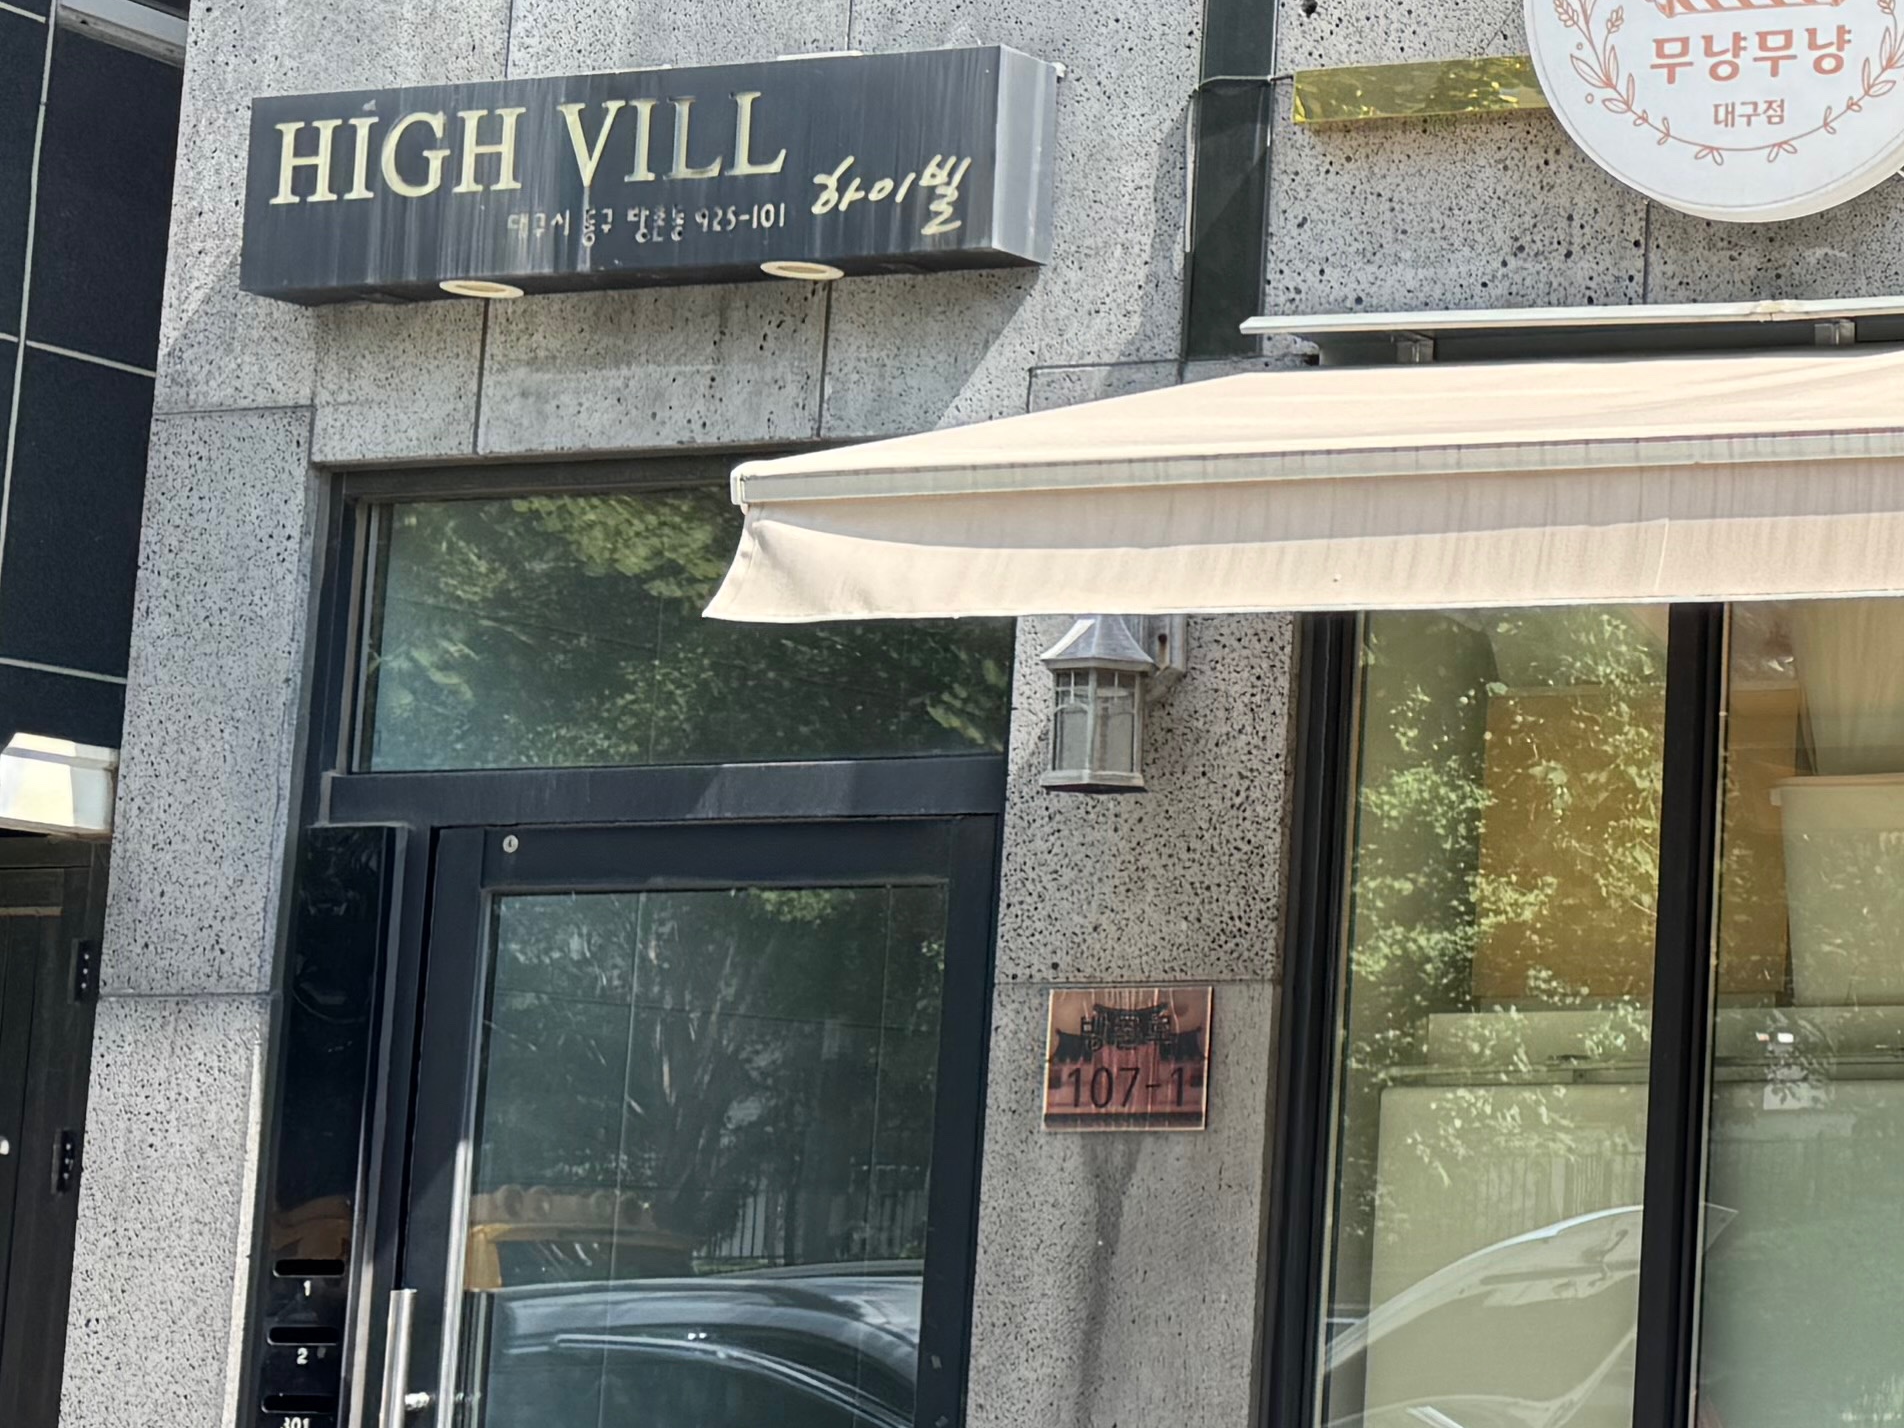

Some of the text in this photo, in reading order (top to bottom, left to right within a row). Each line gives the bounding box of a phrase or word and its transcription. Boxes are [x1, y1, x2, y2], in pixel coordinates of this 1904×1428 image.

[1650, 24, 1852, 85] 무냥무냥
[1713, 99, 1785, 128] 대구점
[269, 91, 788, 204] HIGH VILL
[811, 154, 971, 235] 하이빌
[507, 209, 570, 238] 대구시
[695, 202, 786, 232] 925-101
[1068, 1067, 1184, 1108] 107-1
[303, 1280, 312, 1296] 1
[296, 1347, 308, 1365] 2
